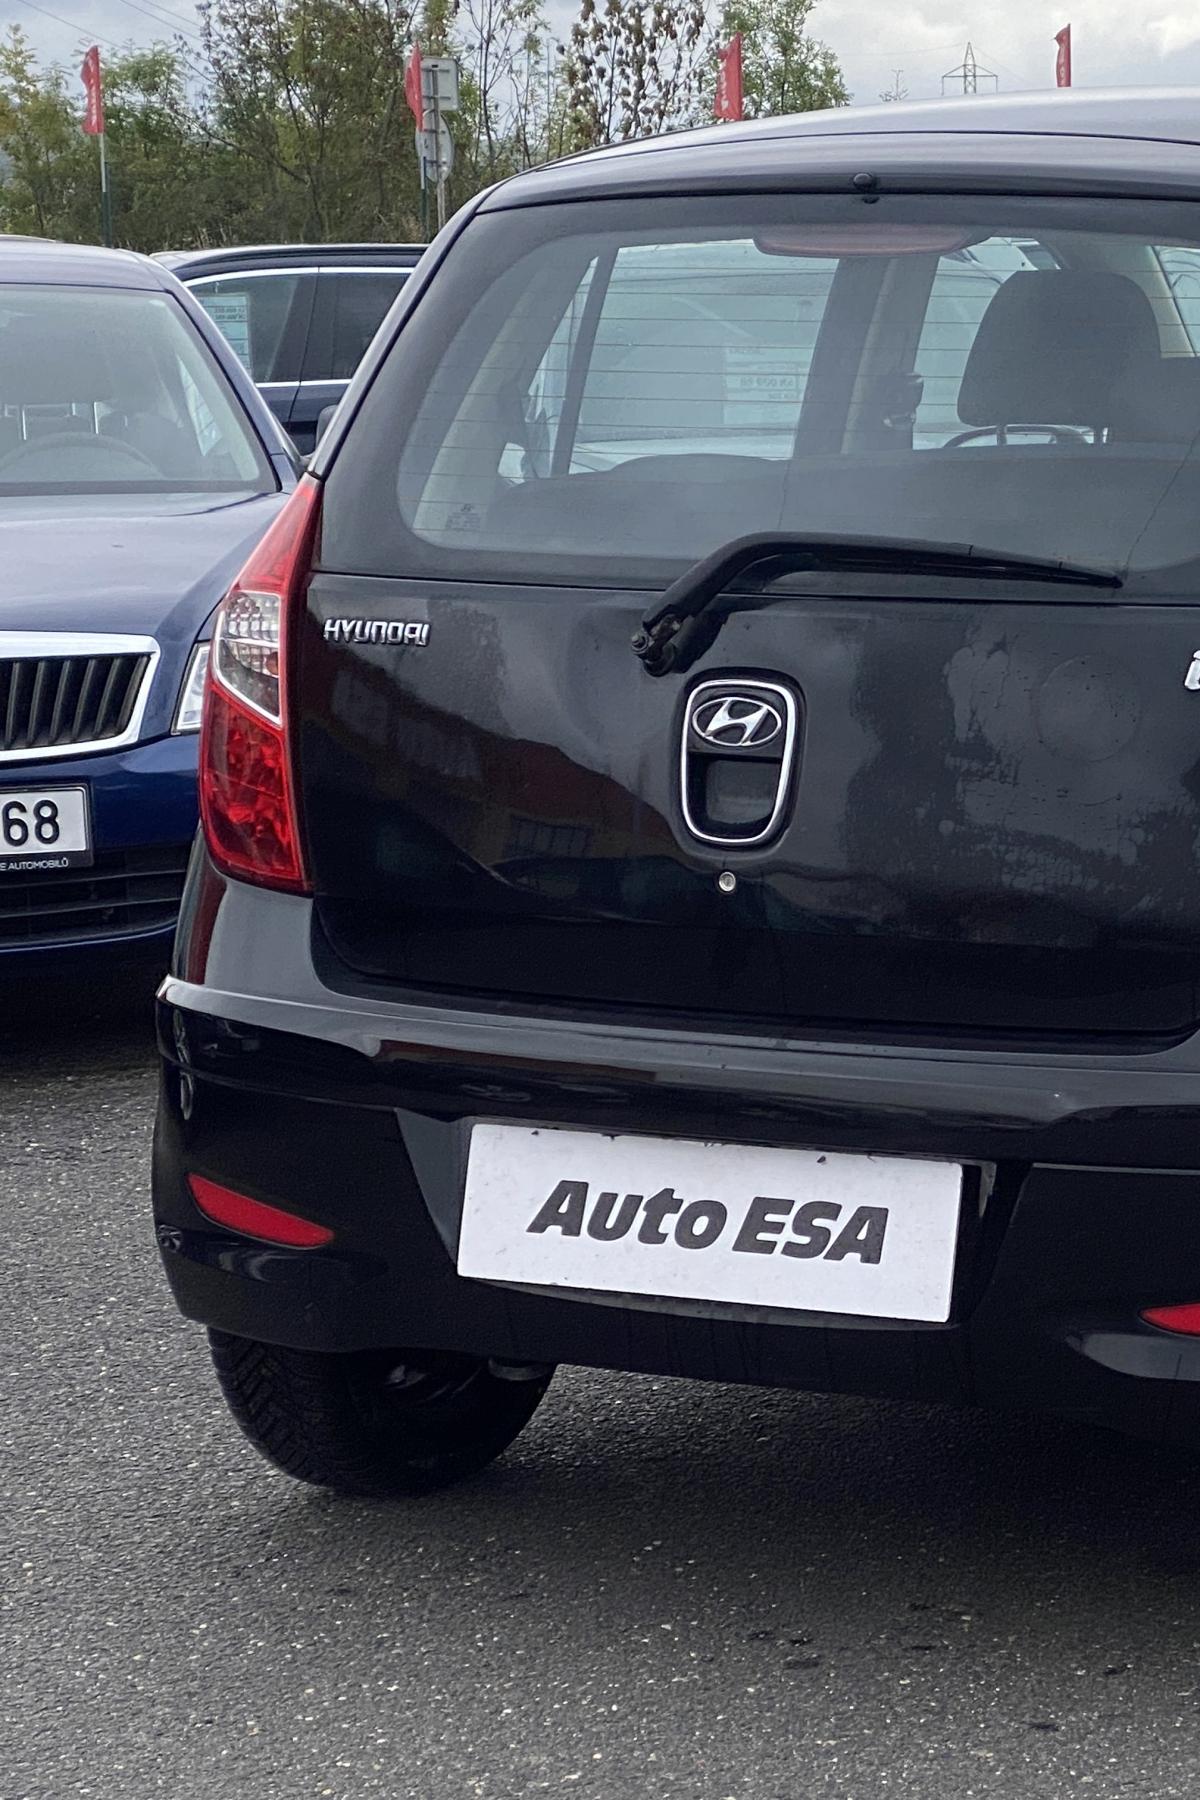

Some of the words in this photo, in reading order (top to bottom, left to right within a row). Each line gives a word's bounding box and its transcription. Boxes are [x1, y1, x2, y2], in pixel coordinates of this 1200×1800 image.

[323, 619, 431, 646] HYUNDAI
[2, 799, 60, 847] 68
[8, 857, 69, 870] AUTOMOBILŮ
[526, 1180, 728, 1250] Auto
[732, 1196, 889, 1265] ESA
